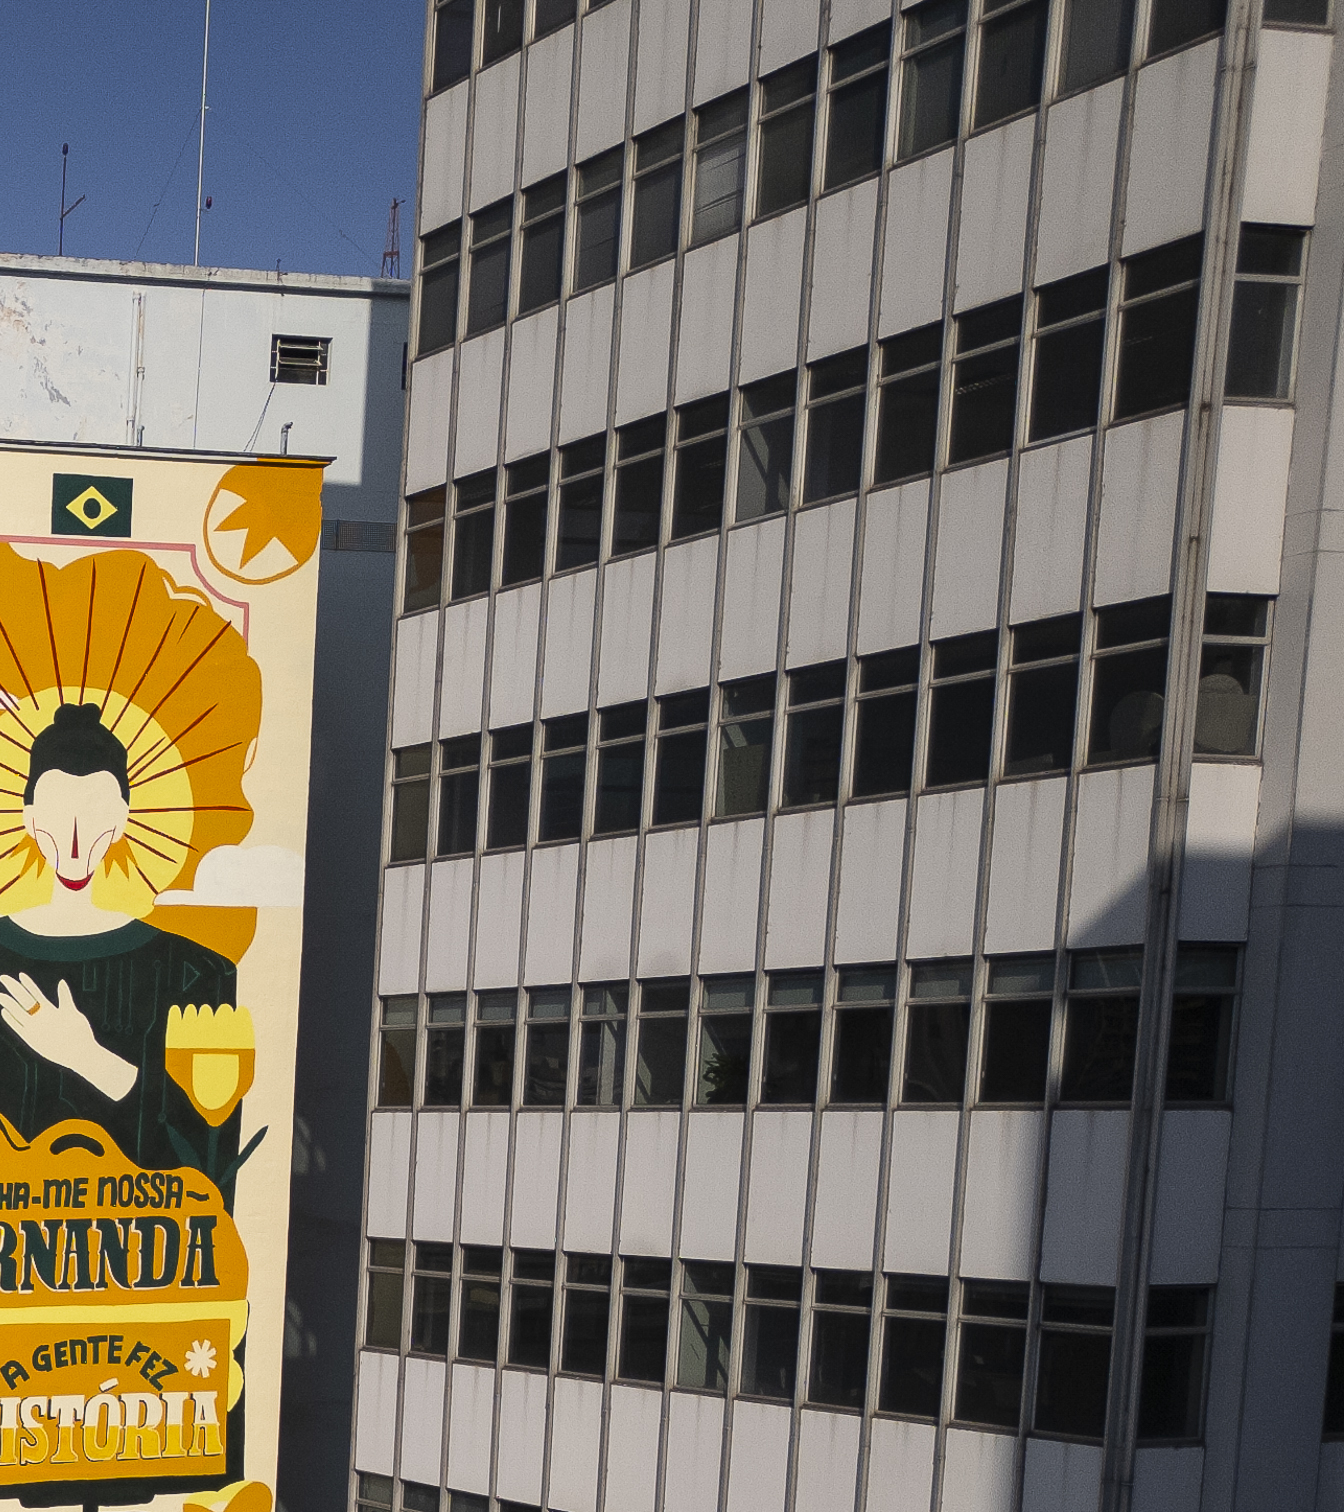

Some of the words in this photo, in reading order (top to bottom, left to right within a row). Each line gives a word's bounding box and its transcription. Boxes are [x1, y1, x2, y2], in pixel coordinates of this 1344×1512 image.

[97, 1172, 183, 1208] NOSSA
[0, 1359, 31, 1390] A
[32, 1335, 124, 1373] GENTE
[125, 1340, 180, 1392] FEZ
